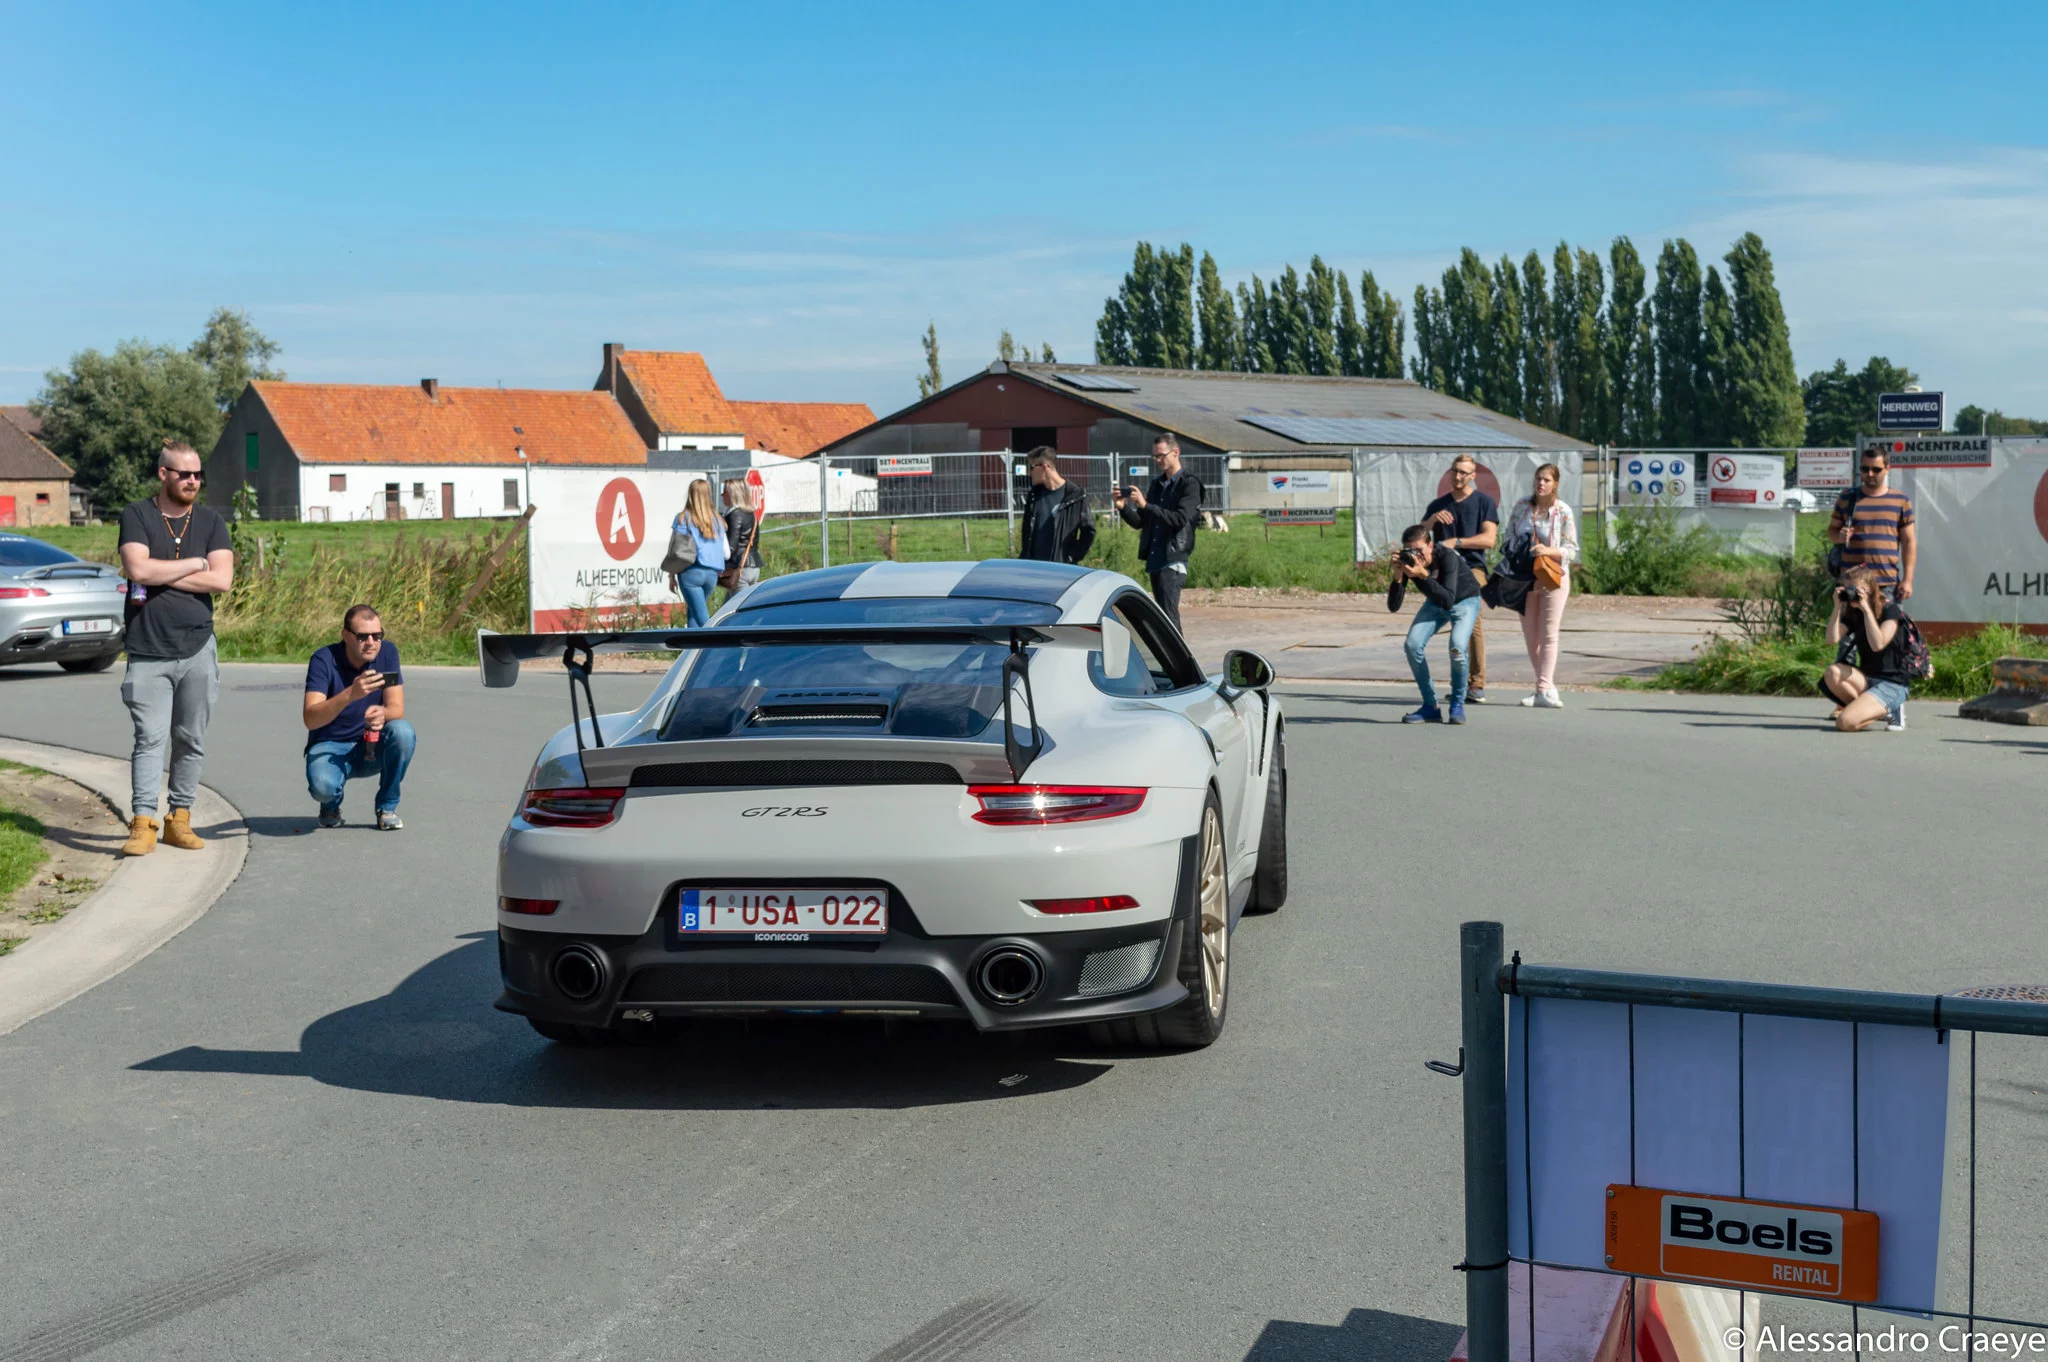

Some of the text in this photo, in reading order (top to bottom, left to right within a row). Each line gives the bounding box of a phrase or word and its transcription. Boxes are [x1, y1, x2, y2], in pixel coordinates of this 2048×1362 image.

[1882, 402, 1938, 412] HERENWEG
[1890, 455, 1909, 464] DEN
[576, 568, 664, 587] ALHEEMBOUW
[741, 806, 828, 817] GT2RS
[685, 913, 696, 926] B
[1670, 1203, 1833, 1256] Boels
[1772, 1263, 1832, 1286] RENTAL
